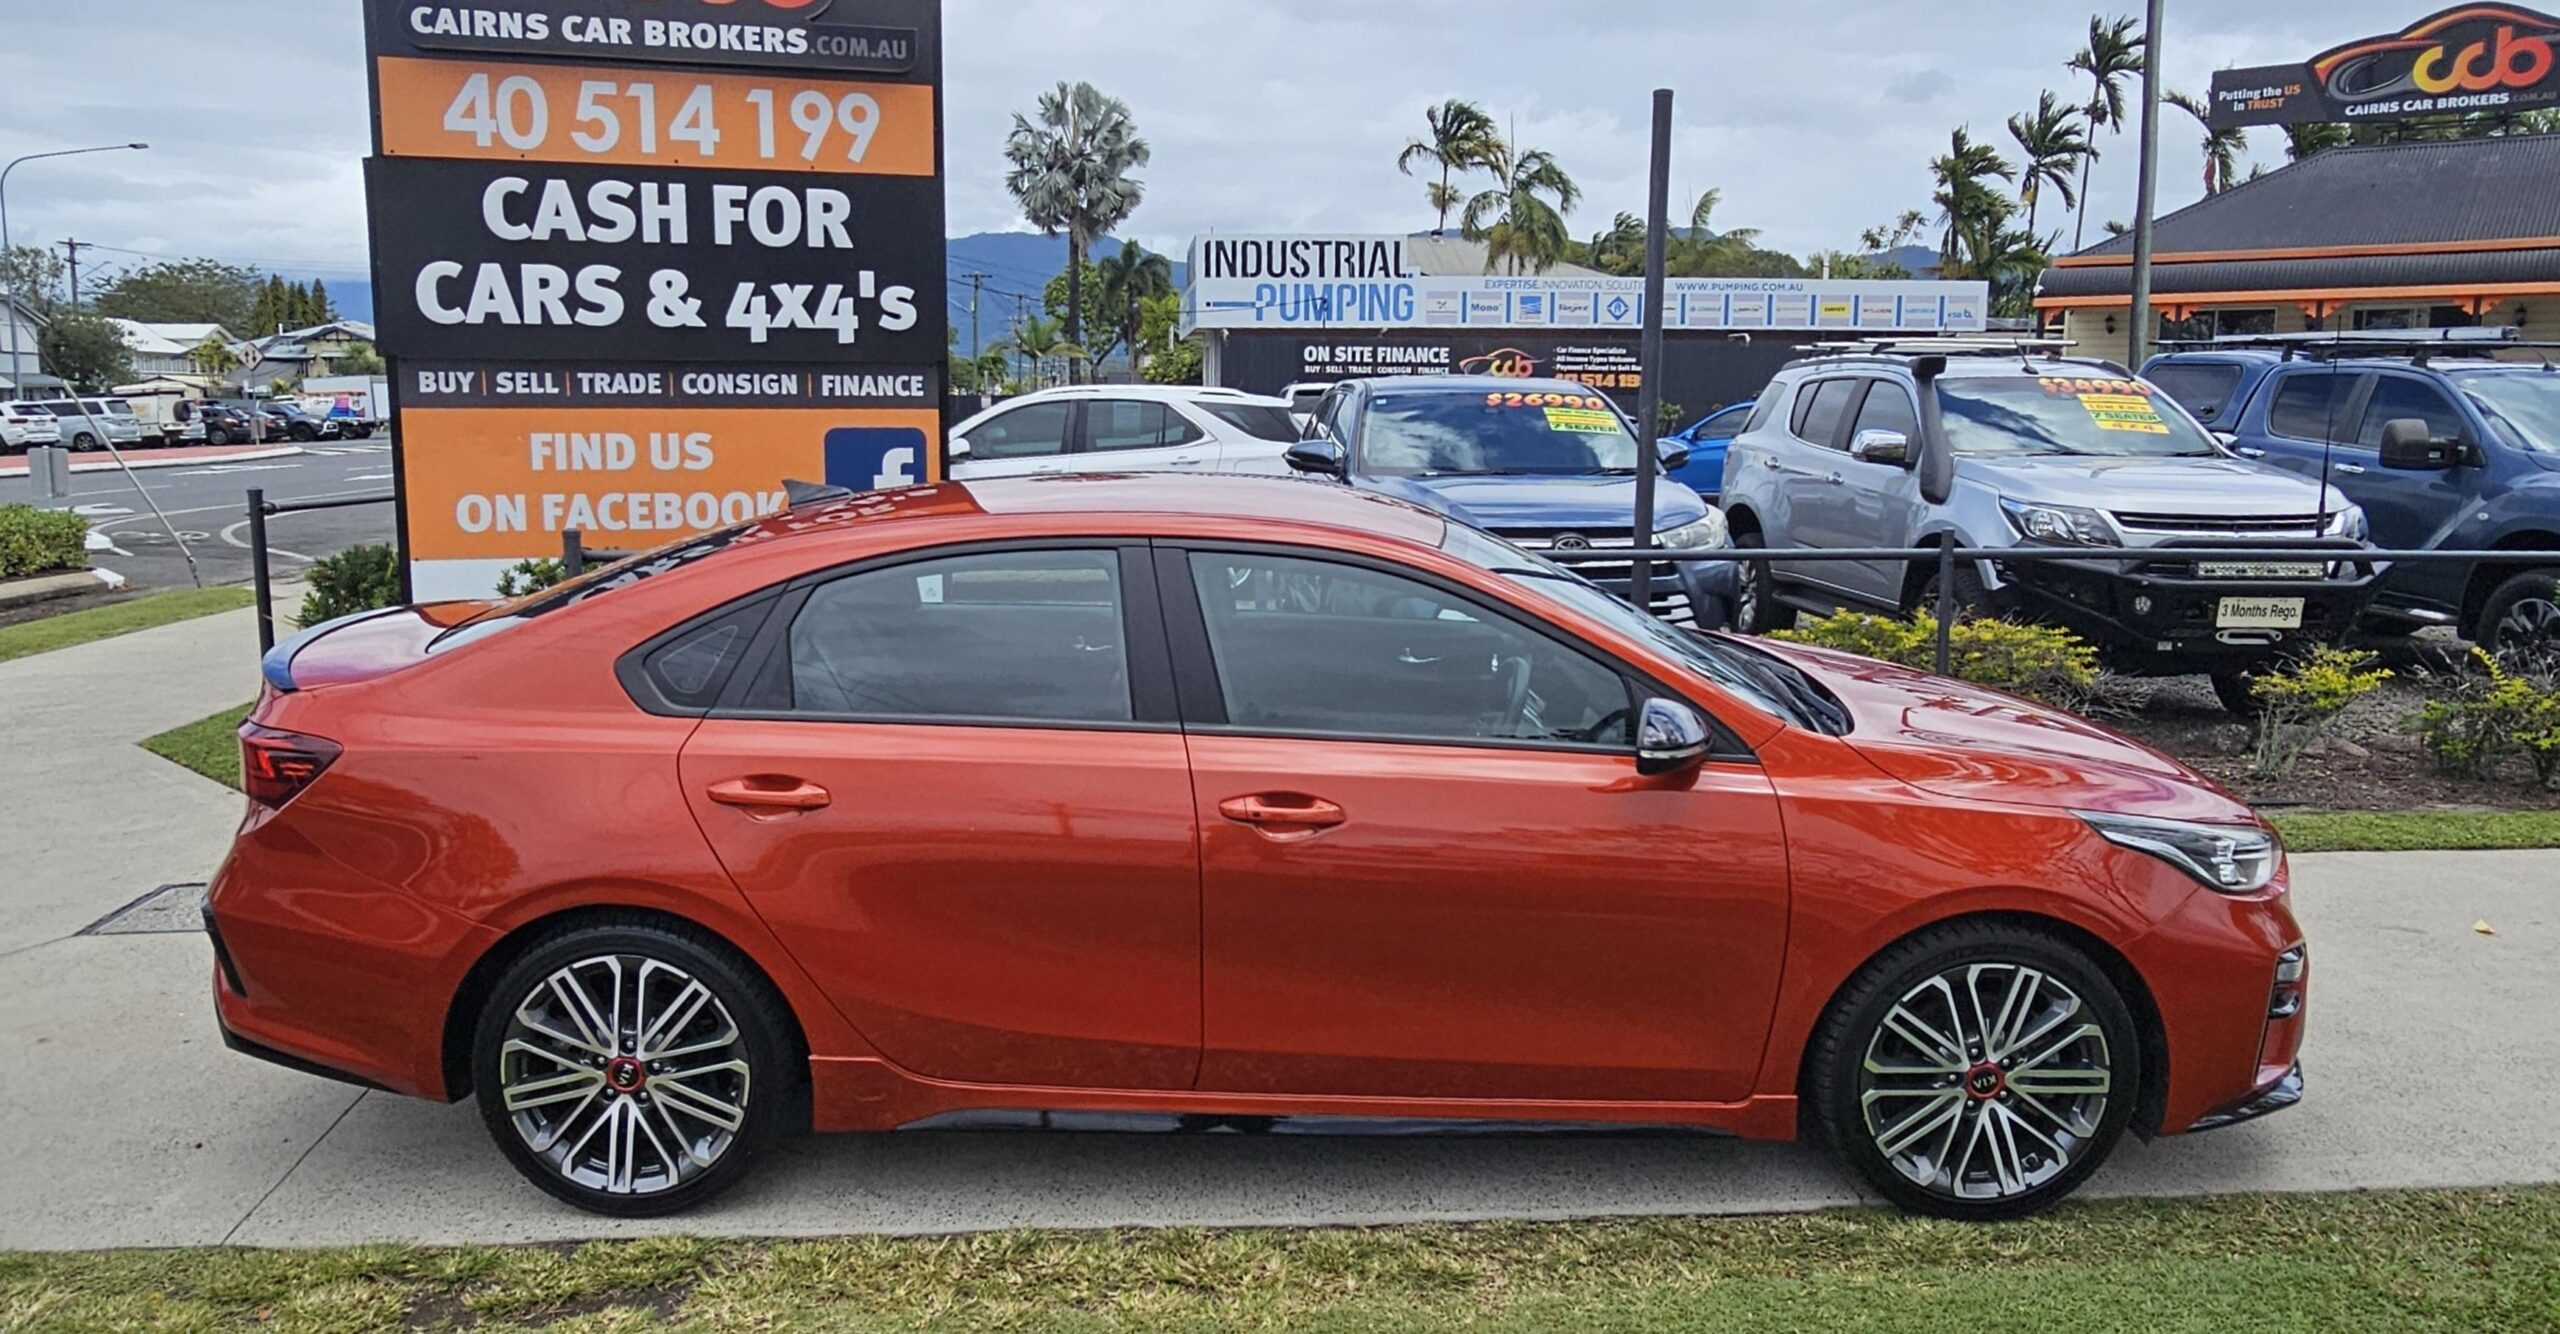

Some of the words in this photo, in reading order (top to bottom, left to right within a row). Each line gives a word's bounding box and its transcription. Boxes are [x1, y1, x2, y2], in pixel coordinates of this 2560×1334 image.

[411, 6, 549, 41] CAIRNS
[562, 15, 632, 45] CAR
[2219, 89, 2260, 101] Putting
[2263, 87, 2282, 97] the
[2284, 84, 2301, 95] US
[2247, 98, 2285, 110] TRUST
[2345, 102, 2399, 116] CAIRNS
[2403, 98, 2433, 111] CAR
[443, 73, 548, 150] 40
[570, 80, 721, 156] 514
[746, 89, 880, 163] 199
[482, 176, 688, 243] CASH
[713, 184, 854, 249] FOR
[415, 260, 625, 326] CARS
[647, 268, 707, 327] &
[1675, 282, 1804, 292] WWW.PUMPING.COM.AU
[1255, 283, 1414, 322] PUMPING
[1471, 303, 1499, 312] Mono
[1303, 345, 1330, 362] ON
[1334, 345, 1373, 362] SITE
[1377, 347, 1450, 363] FINANCE
[1304, 365, 1321, 373] BUY
[1325, 365, 1343, 374] SELL
[1348, 366, 1372, 374] TRADE
[1377, 366, 1412, 374] CONSIGN
[1417, 367, 1449, 375] FINANCE
[418, 371, 474, 393] BUY
[496, 371, 559, 394] SELL
[578, 372, 663, 395] TRADE
[682, 373, 798, 395] CONSIGN
[822, 374, 924, 397] FINANCE
[1486, 392, 1605, 410] $26990
[2105, 412, 2159, 421] SEATER
[1565, 423, 1618, 432] SEATER
[530, 433, 635, 471] FIND
[651, 433, 714, 470] US
[456, 494, 527, 532] ON
[543, 490, 788, 532] FACEBOOK
[2221, 604, 2229, 617] 3
[2230, 604, 2267, 617] Months
[2270, 604, 2298, 621] Rego.
